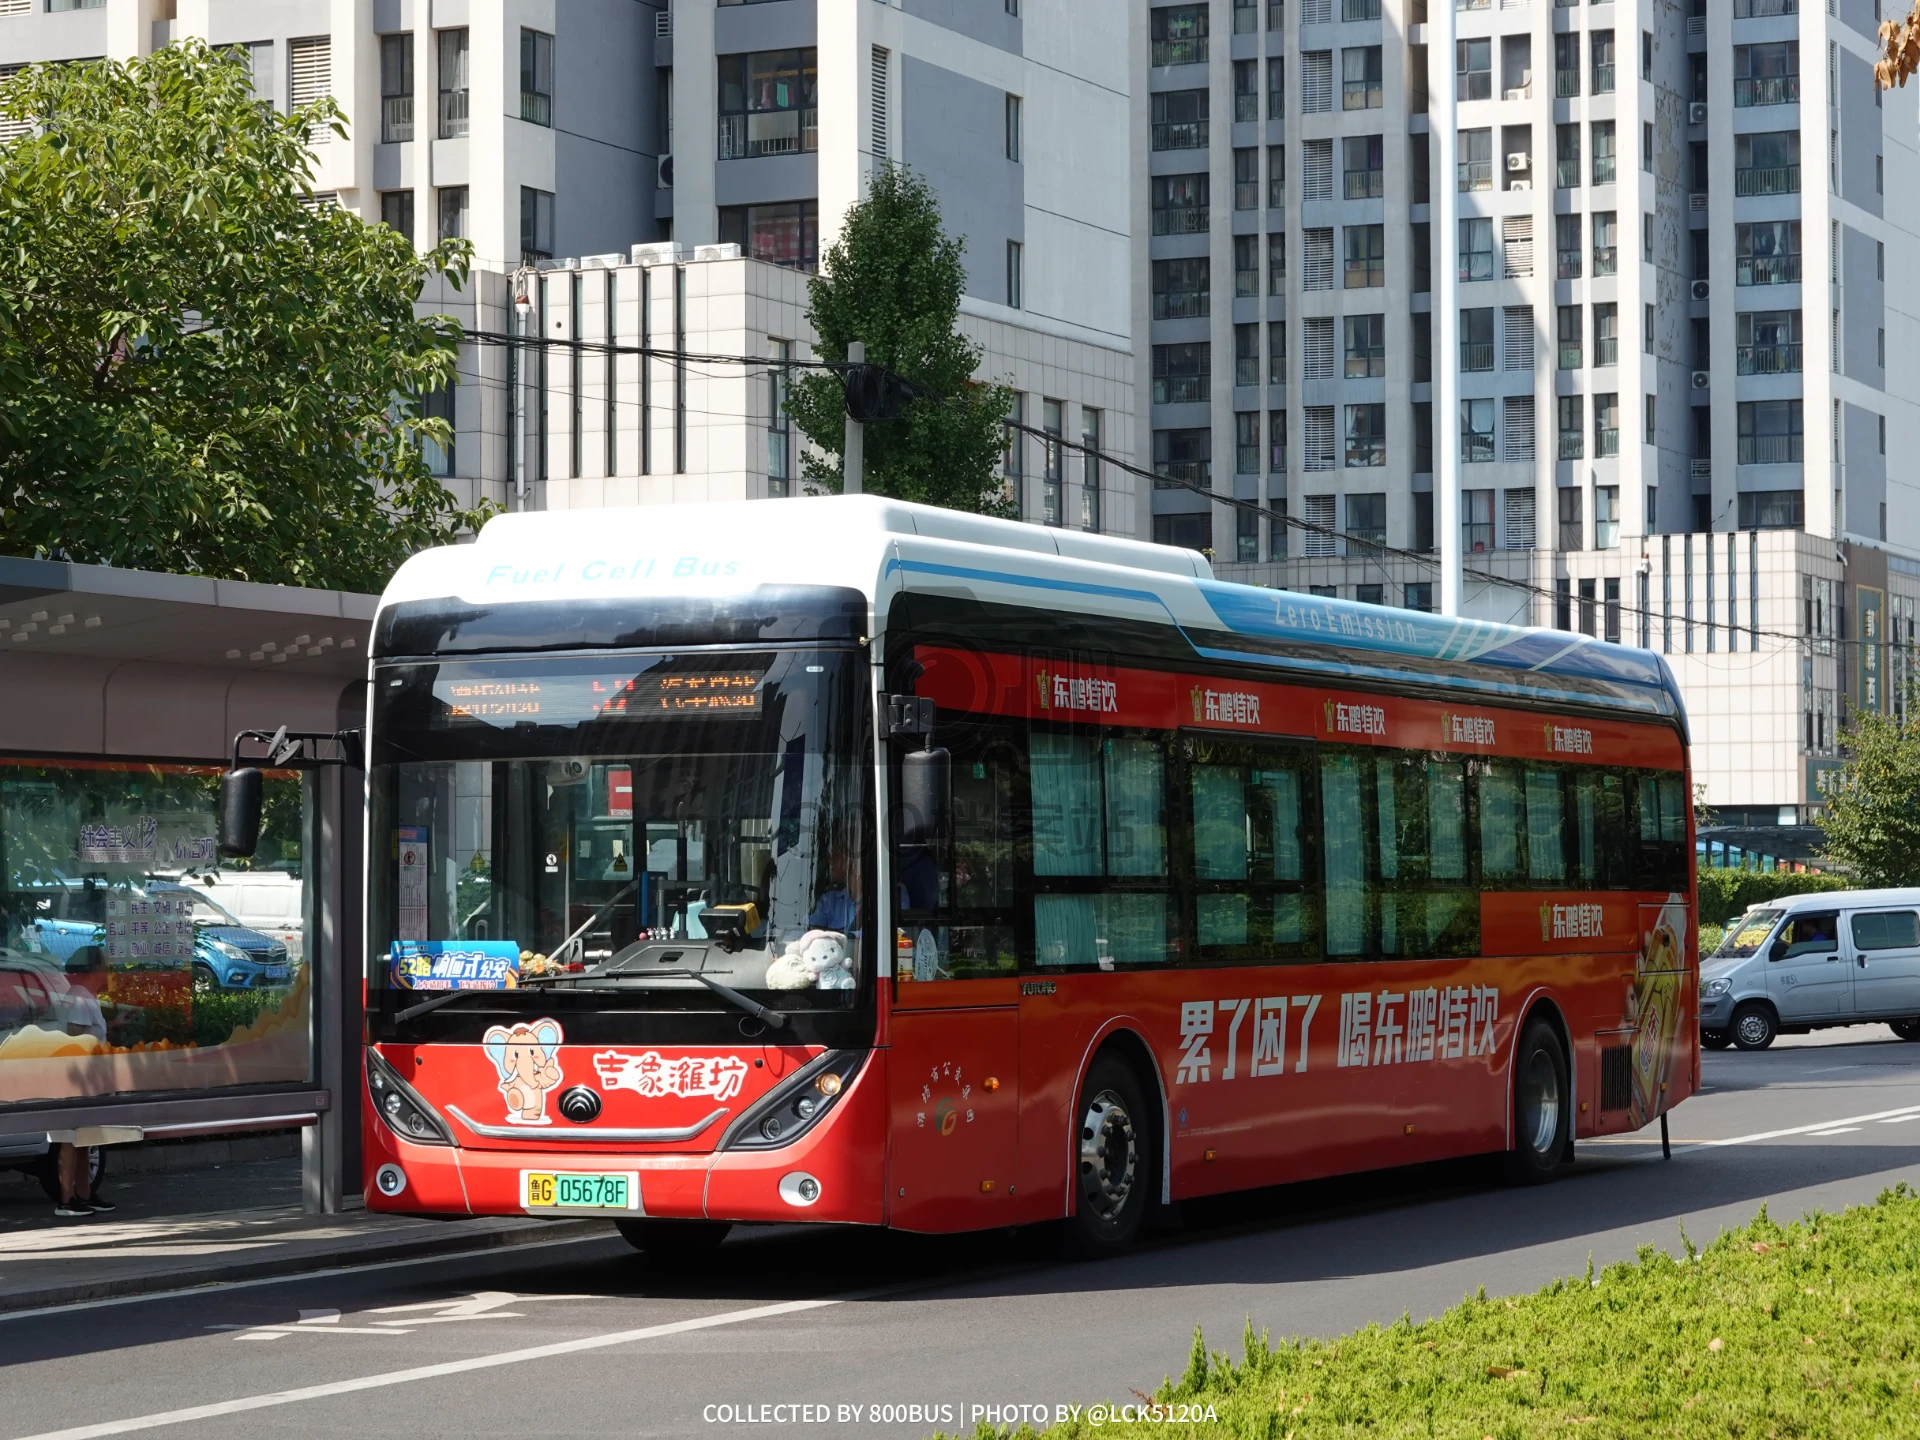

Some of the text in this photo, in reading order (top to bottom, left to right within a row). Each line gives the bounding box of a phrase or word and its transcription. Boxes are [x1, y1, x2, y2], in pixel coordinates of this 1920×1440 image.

[484, 556, 740, 587] Fuel Cell Bus
[1271, 598, 1417, 643] Zero Emission
[1053, 674, 1118, 713] 东鹏特饮
[1204, 689, 1261, 725] 东鹏特饮
[1336, 701, 1386, 735] 东鹏特饮
[1452, 714, 1496, 745] 东鹏特饮
[1553, 725, 1593, 755] 东鹏特饮
[131, 901, 148, 915] 民主
[153, 901, 171, 915] 文明
[1553, 903, 1603, 938] 东鹏特饮
[131, 921, 148, 935] 平等
[153, 921, 171, 935] 公正
[400, 954, 508, 978] 52路 响应式公交
[1021, 981, 1057, 996] YUTONG
[1176, 983, 1499, 1085] 累了困了 喝东鹏特饮
[560, 1179, 626, 1203] 05678F
